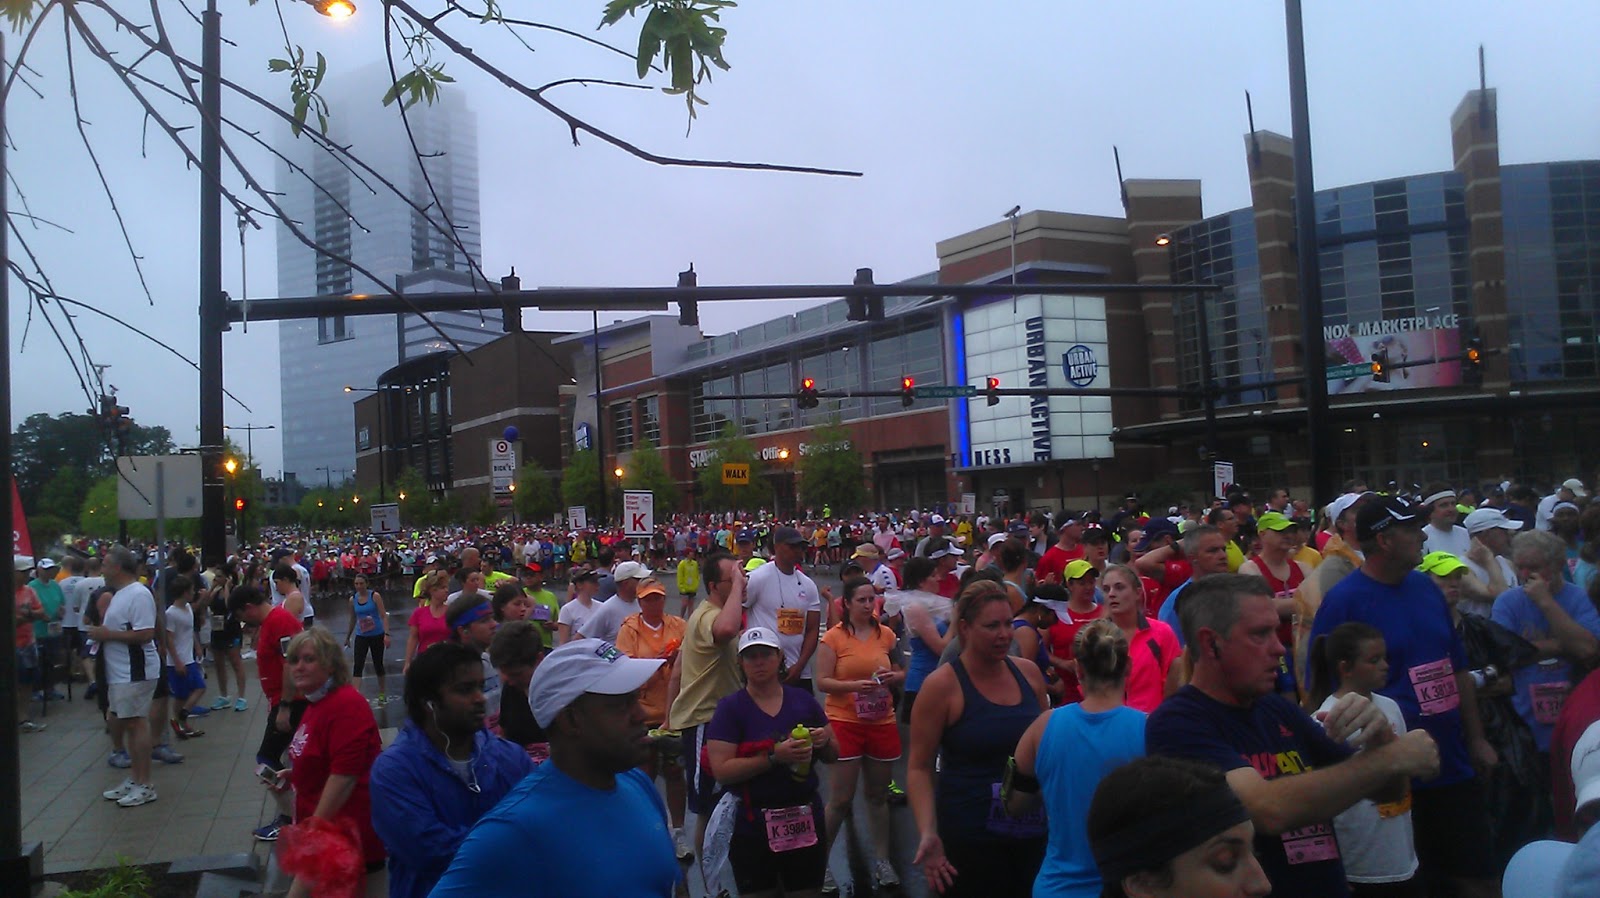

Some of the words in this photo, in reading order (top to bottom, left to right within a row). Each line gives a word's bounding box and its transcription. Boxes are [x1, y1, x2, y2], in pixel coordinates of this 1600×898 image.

[1323, 324, 1350, 340] NOX
[1358, 314, 1460, 337] MARKETPLACE
[1025, 316, 1046, 388] URBAN
[1067, 351, 1096, 366] URBAN
[1070, 362, 1097, 379] ACTIVE
[1030, 394, 1051, 462] ACTIVE
[725, 469, 747, 479] WALK
[381, 520, 391, 531] L
[574, 519, 582, 528] L
[632, 513, 647, 531] K
[1421, 687, 1431, 700] K
[772, 825, 780, 838] K
[782, 820, 811, 837] 39884
